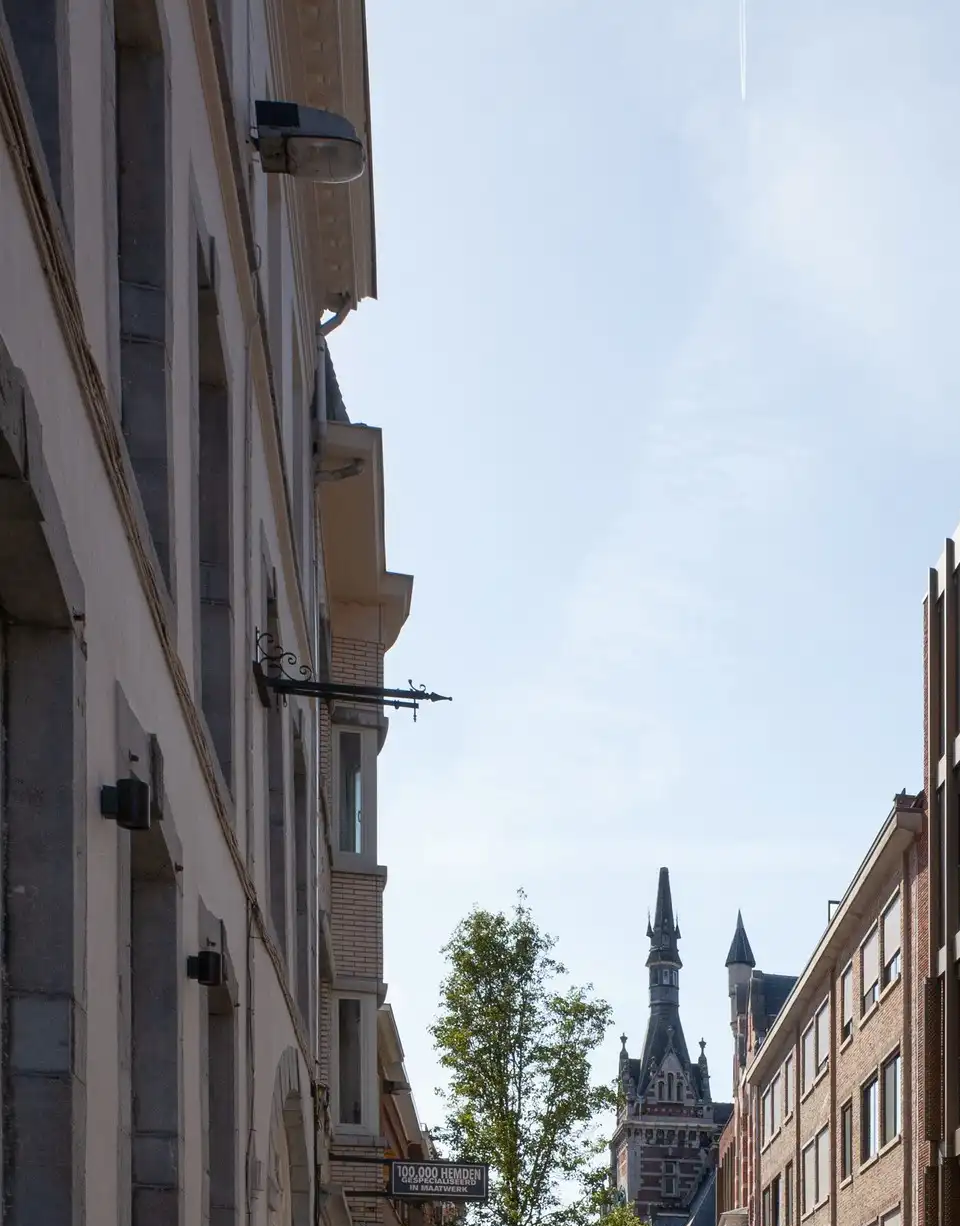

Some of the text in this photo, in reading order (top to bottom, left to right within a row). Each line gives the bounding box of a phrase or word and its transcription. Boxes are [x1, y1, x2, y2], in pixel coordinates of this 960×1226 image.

[440, 1167, 481, 1181] HEMDEN
[401, 1176, 477, 1186] GESPECIALISEERD
[420, 1185, 468, 1193] MAATWERK
